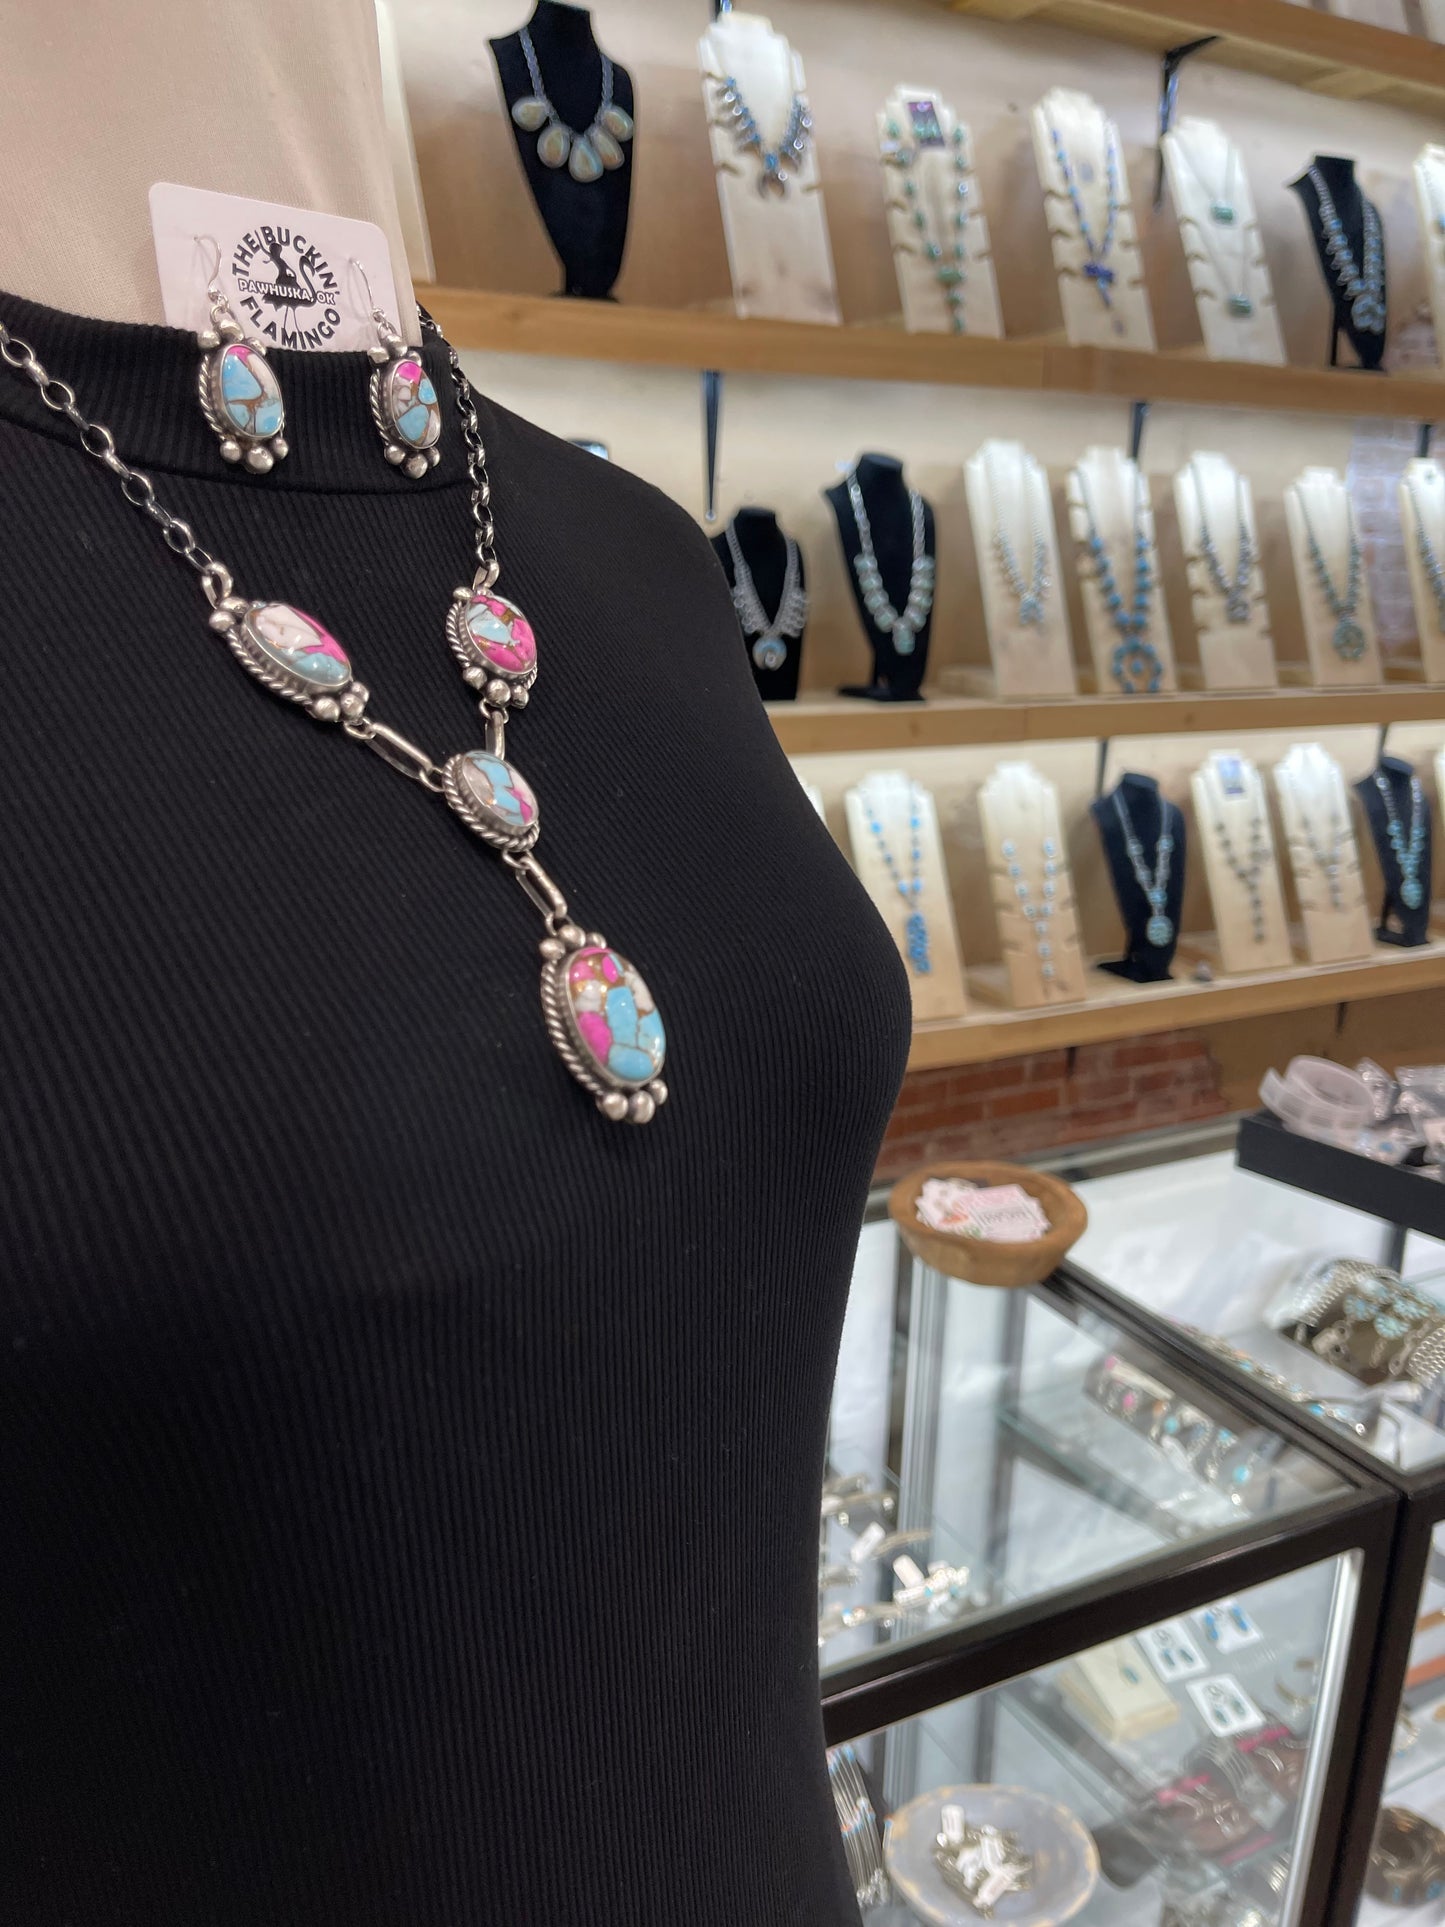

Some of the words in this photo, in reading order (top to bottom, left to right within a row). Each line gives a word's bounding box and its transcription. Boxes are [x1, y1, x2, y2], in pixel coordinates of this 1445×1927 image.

[232, 233, 260, 277] THE
[238, 279, 314, 302] PAWHUSKA,
[316, 291, 335, 305] OK
[240, 296, 341, 349] FLAMINGO
